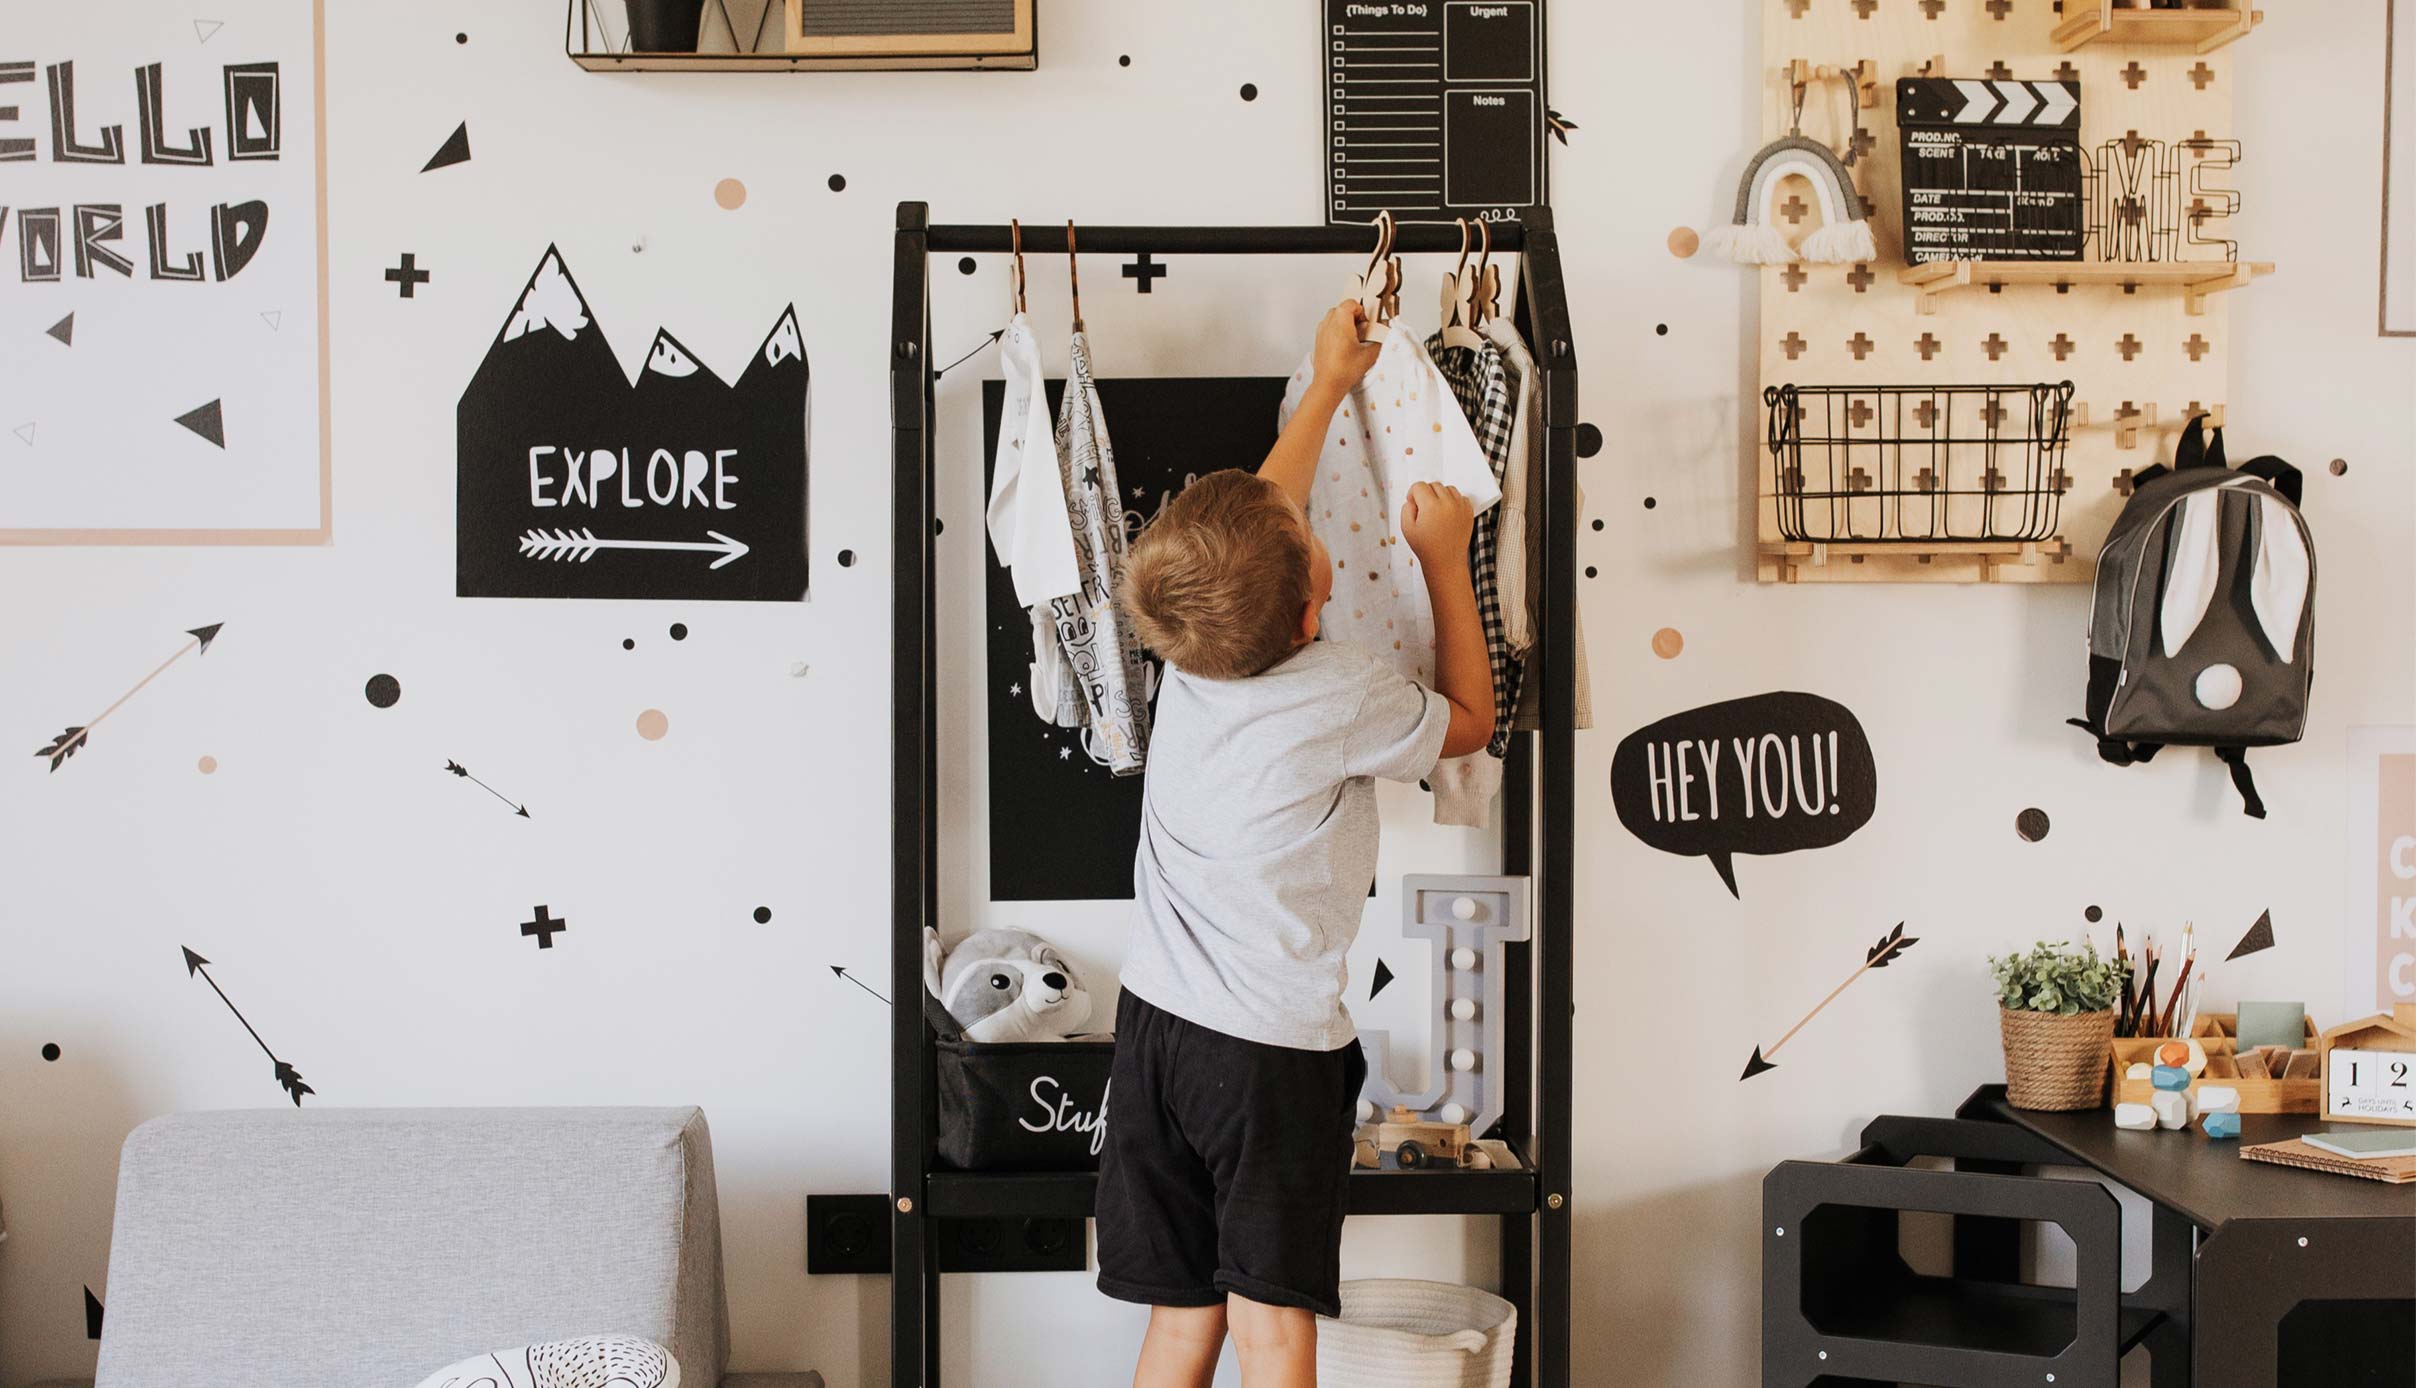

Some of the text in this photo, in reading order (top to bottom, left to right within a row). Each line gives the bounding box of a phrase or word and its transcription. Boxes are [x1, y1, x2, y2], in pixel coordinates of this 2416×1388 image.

[1391, 4, 1405, 15] To
[1470, 6, 1508, 18] Urgent
[1473, 95, 1505, 106] Notes
[0, 60, 280, 167] ELLO
[1918, 148, 1955, 159] SCENE
[1913, 194, 1941, 204] DATE
[0, 200, 268, 282] ORLD
[529, 446, 740, 510] EXPLORE
[1647, 730, 1840, 823] HEY YOU!
[2358, 1104, 2398, 1113] HOLIDAYS
[1018, 1075, 1112, 1156] Stuf
